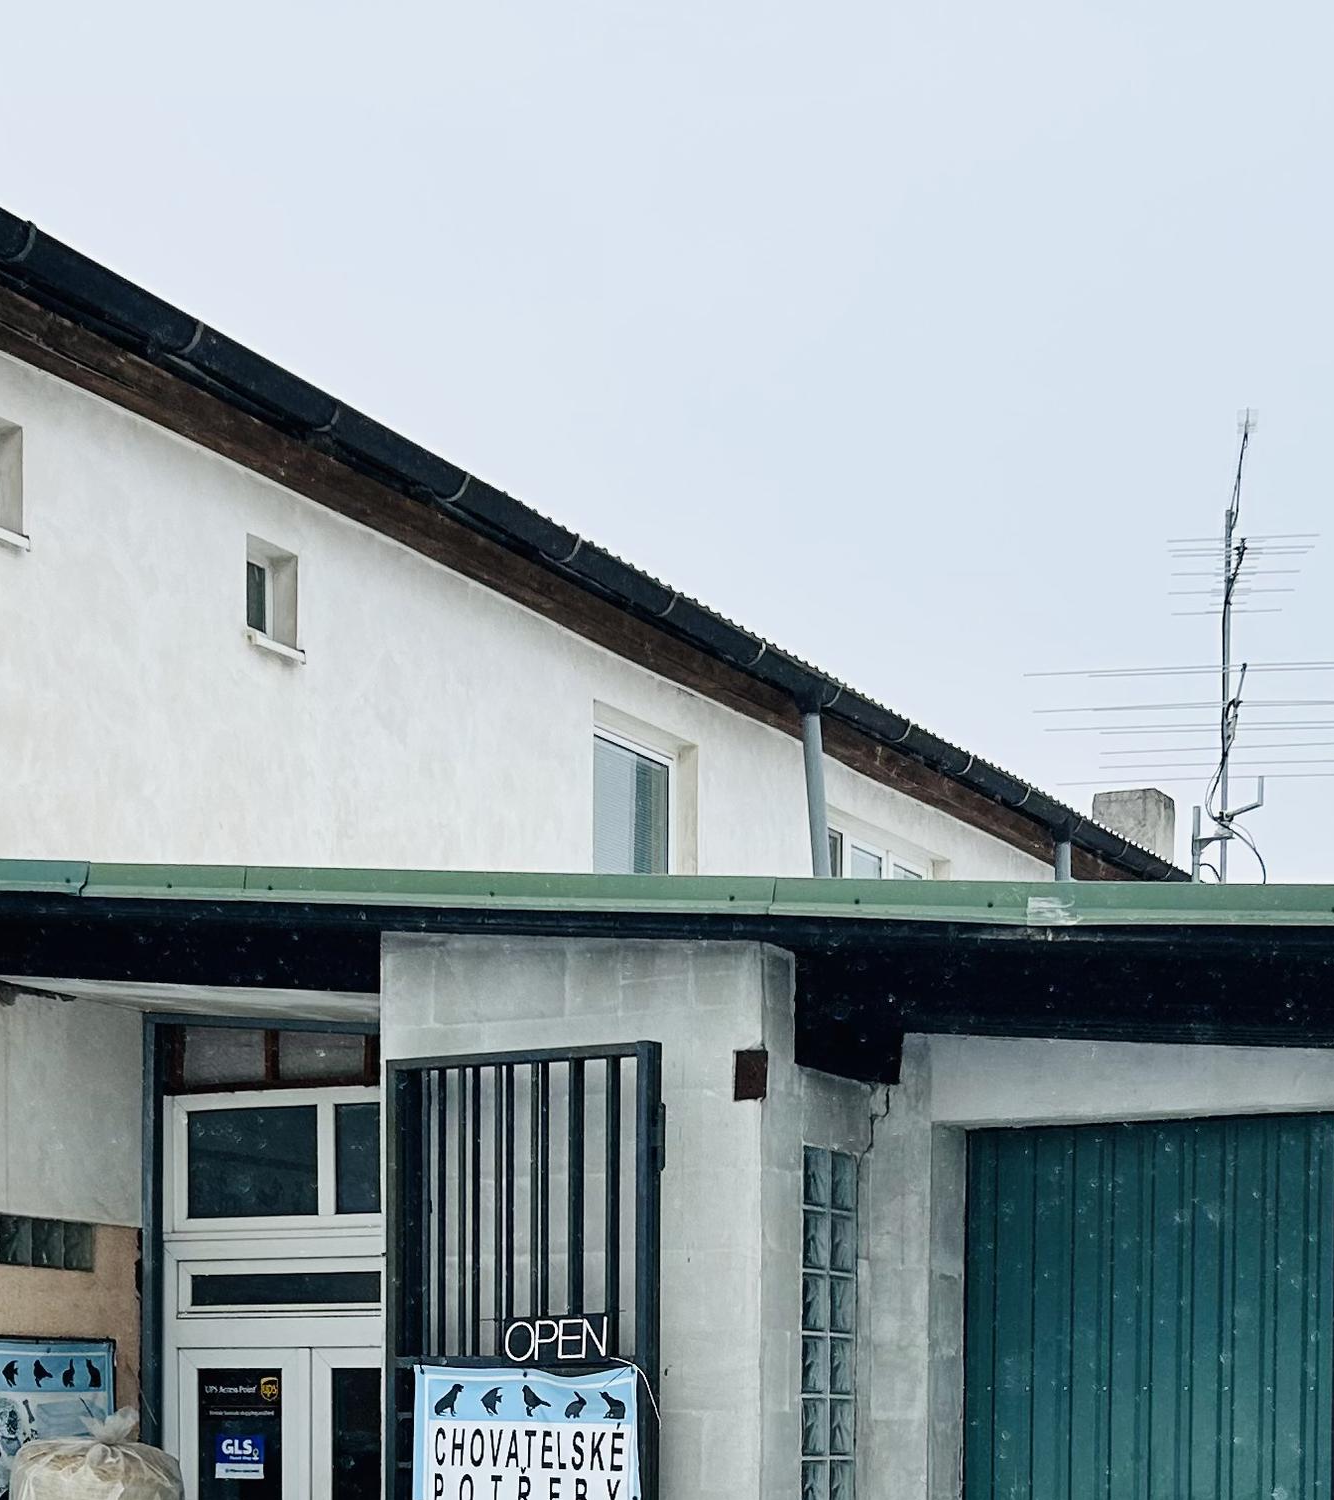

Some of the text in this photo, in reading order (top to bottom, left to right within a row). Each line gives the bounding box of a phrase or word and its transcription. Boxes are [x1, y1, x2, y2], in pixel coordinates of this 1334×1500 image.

[504, 1316, 608, 1362] OPEN
[221, 1439, 253, 1455] GLS
[434, 1423, 625, 1472] CHOVATELSKÉ
